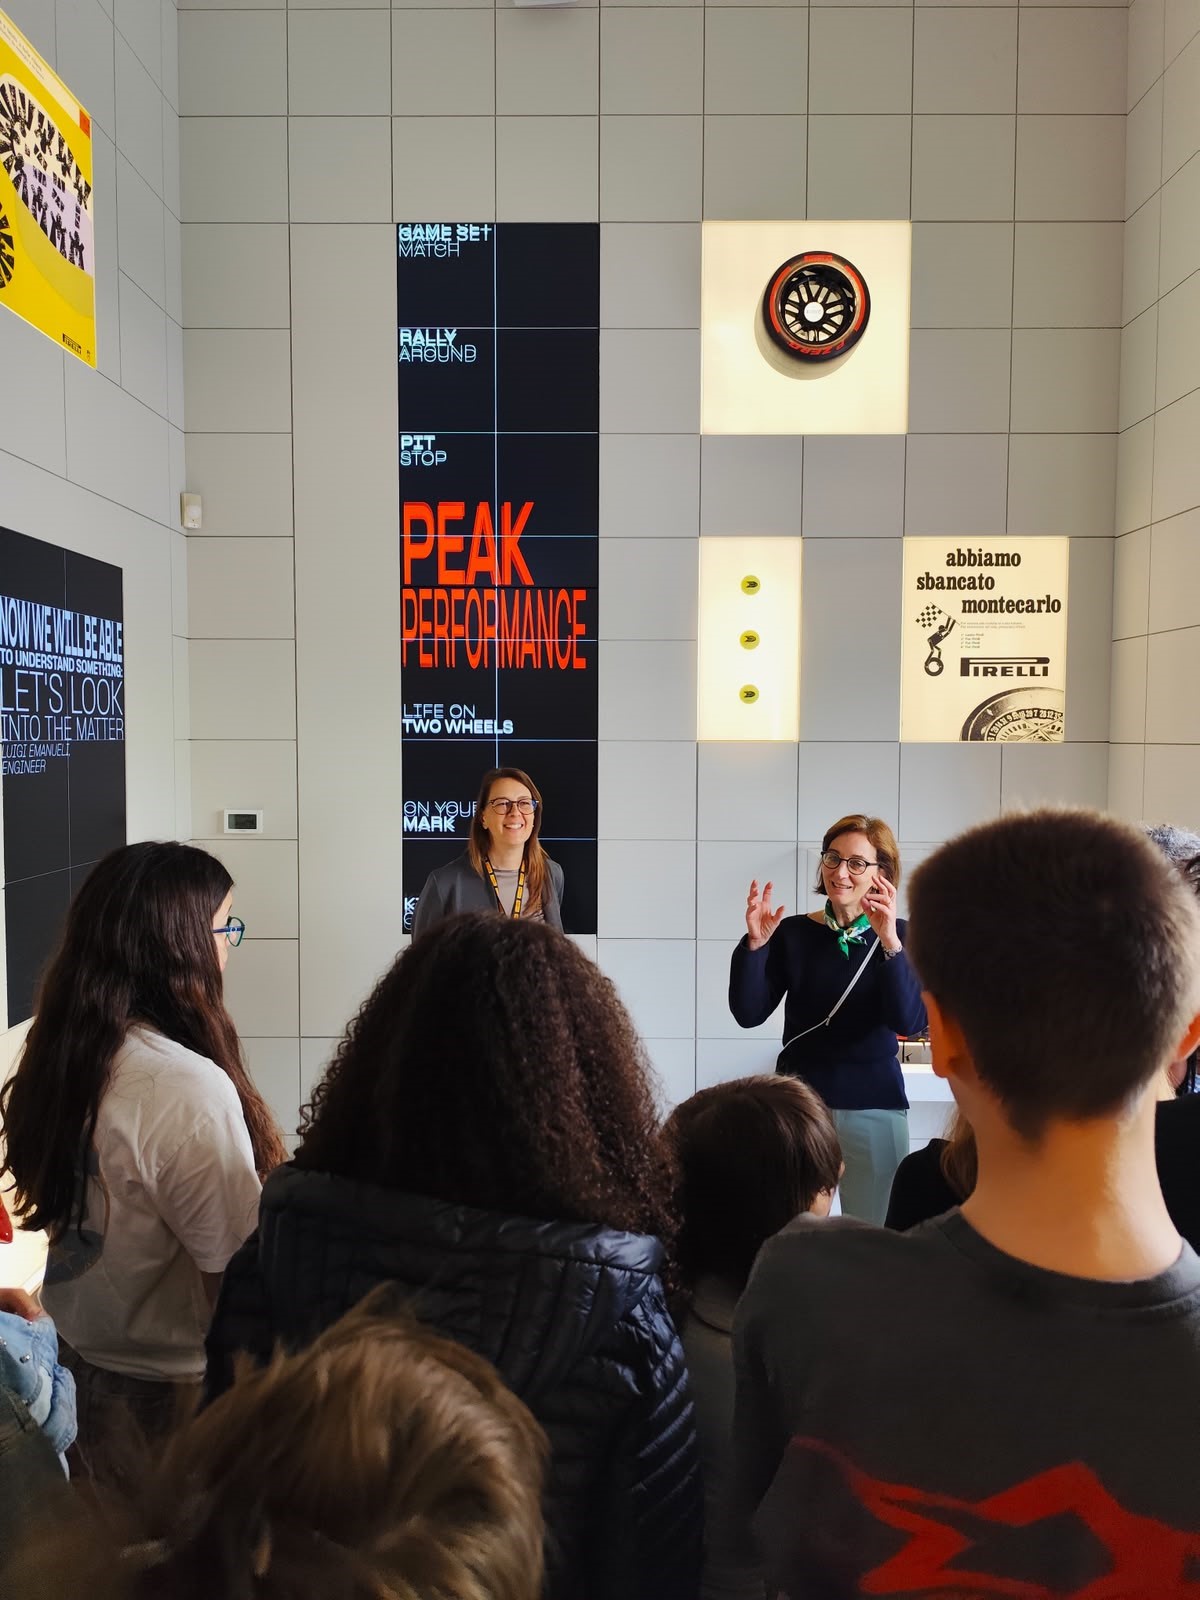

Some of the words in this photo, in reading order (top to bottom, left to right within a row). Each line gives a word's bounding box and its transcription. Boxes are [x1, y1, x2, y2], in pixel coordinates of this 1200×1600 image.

[399, 224, 452, 241] GAME
[456, 224, 492, 241] SET
[399, 240, 460, 257] MATCH
[399, 329, 457, 346] RALLY
[399, 345, 477, 362] AROUND
[400, 435, 436, 450] PIT
[400, 450, 447, 466] STOP
[403, 502, 535, 585] PEAK
[946, 548, 1021, 567] abbiamo
[916, 572, 995, 590] sbancato
[961, 595, 1062, 613] montecarlo
[0, 595, 30, 649] NOW
[31, 602, 52, 652] WE
[53, 607, 84, 657] WILL
[84, 614, 98, 659] BE
[99, 618, 123, 663] ABLE
[402, 588, 587, 669] PERFORMANCE
[0, 647, 14, 665] TO
[15, 649, 75, 673] UNDERSTAND
[960, 657, 1050, 677] PIRELLI
[0, 667, 63, 713] LET'S
[70, 675, 123, 716] LOOK
[403, 704, 444, 719] LIFE
[449, 704, 476, 719] ON
[1, 714, 41, 742] INTO
[44, 715, 72, 741] THE
[76, 716, 124, 741] MATTER
[402, 719, 442, 734] TWO
[445, 719, 514, 735] WHEELS
[1, 743, 27, 759] LUIGI
[2, 759, 46, 776] ENGINEER
[403, 801, 430, 817] ON
[403, 816, 456, 833] MARK
